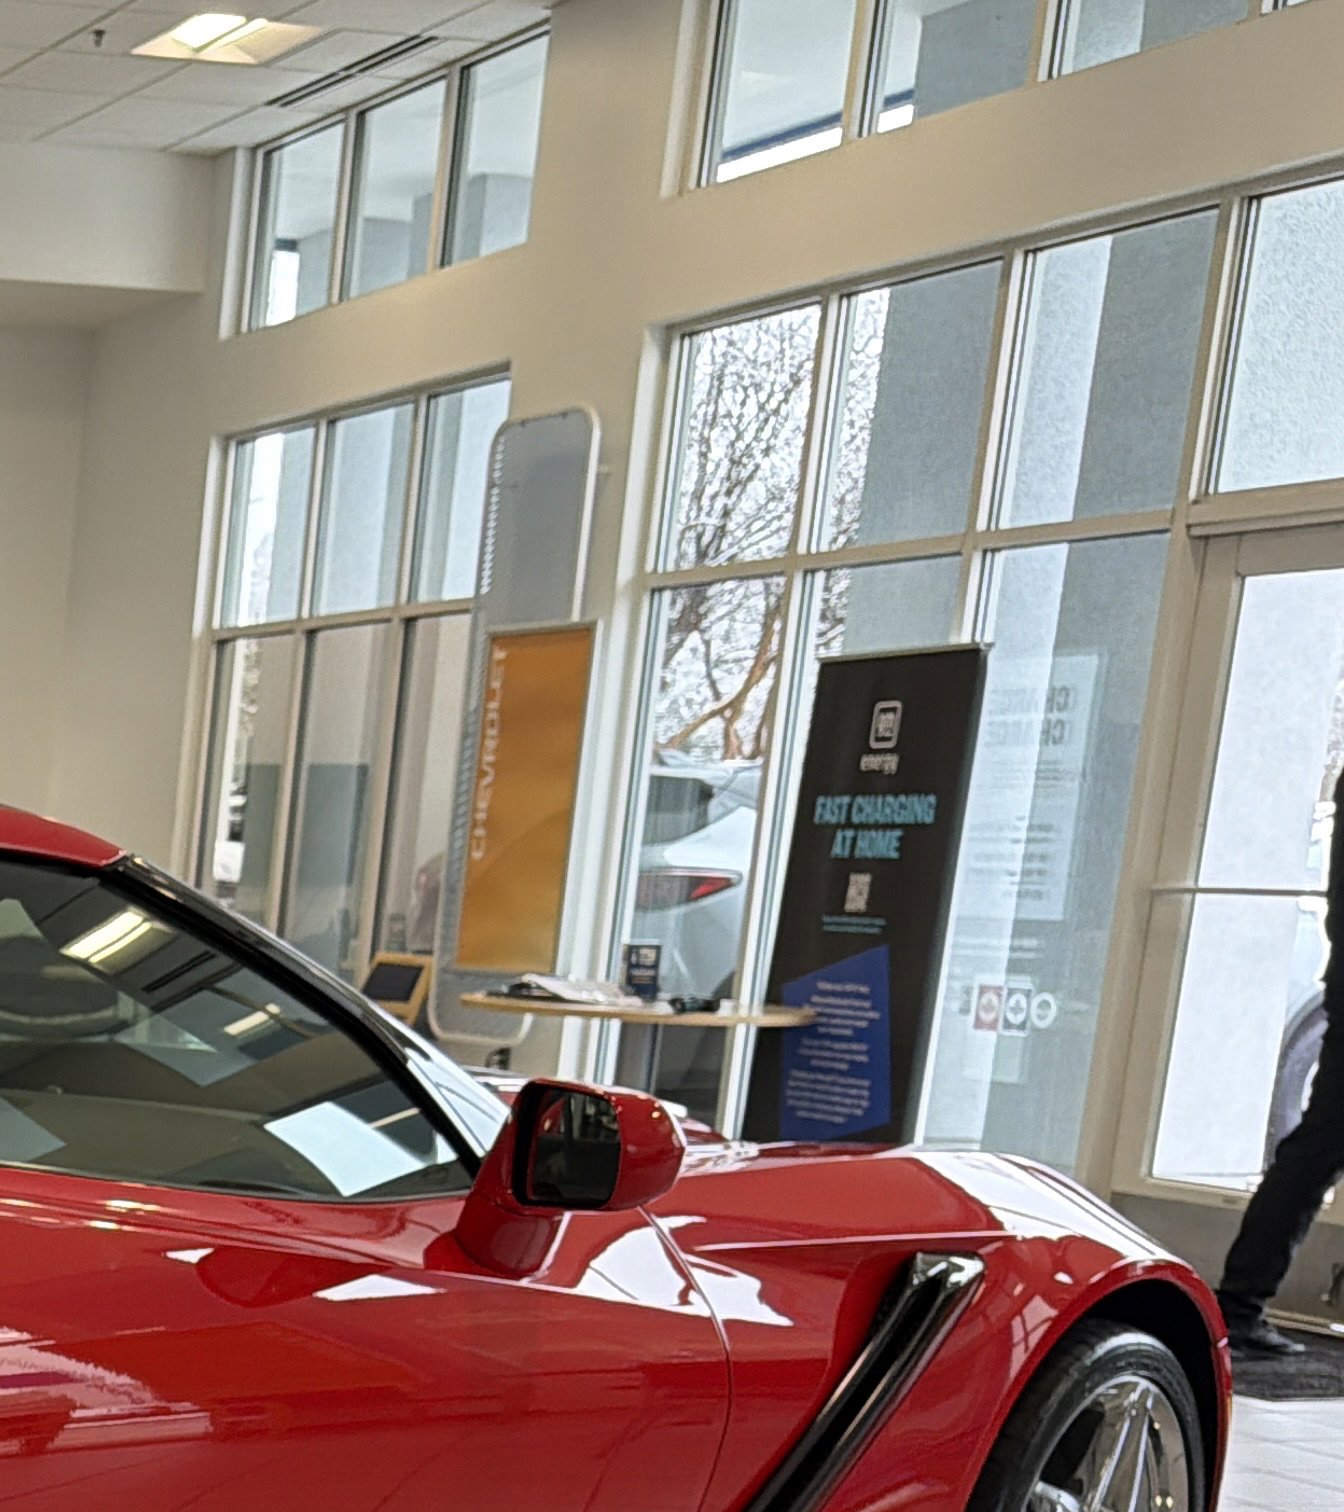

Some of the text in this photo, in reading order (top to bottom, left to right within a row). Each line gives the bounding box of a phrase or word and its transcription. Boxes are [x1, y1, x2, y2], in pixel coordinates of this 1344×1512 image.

[471, 646, 510, 861] CHEVROLET
[859, 752, 900, 775] energy
[813, 793, 937, 825] FAST CHARGING
[830, 828, 905, 859] AT HOME
